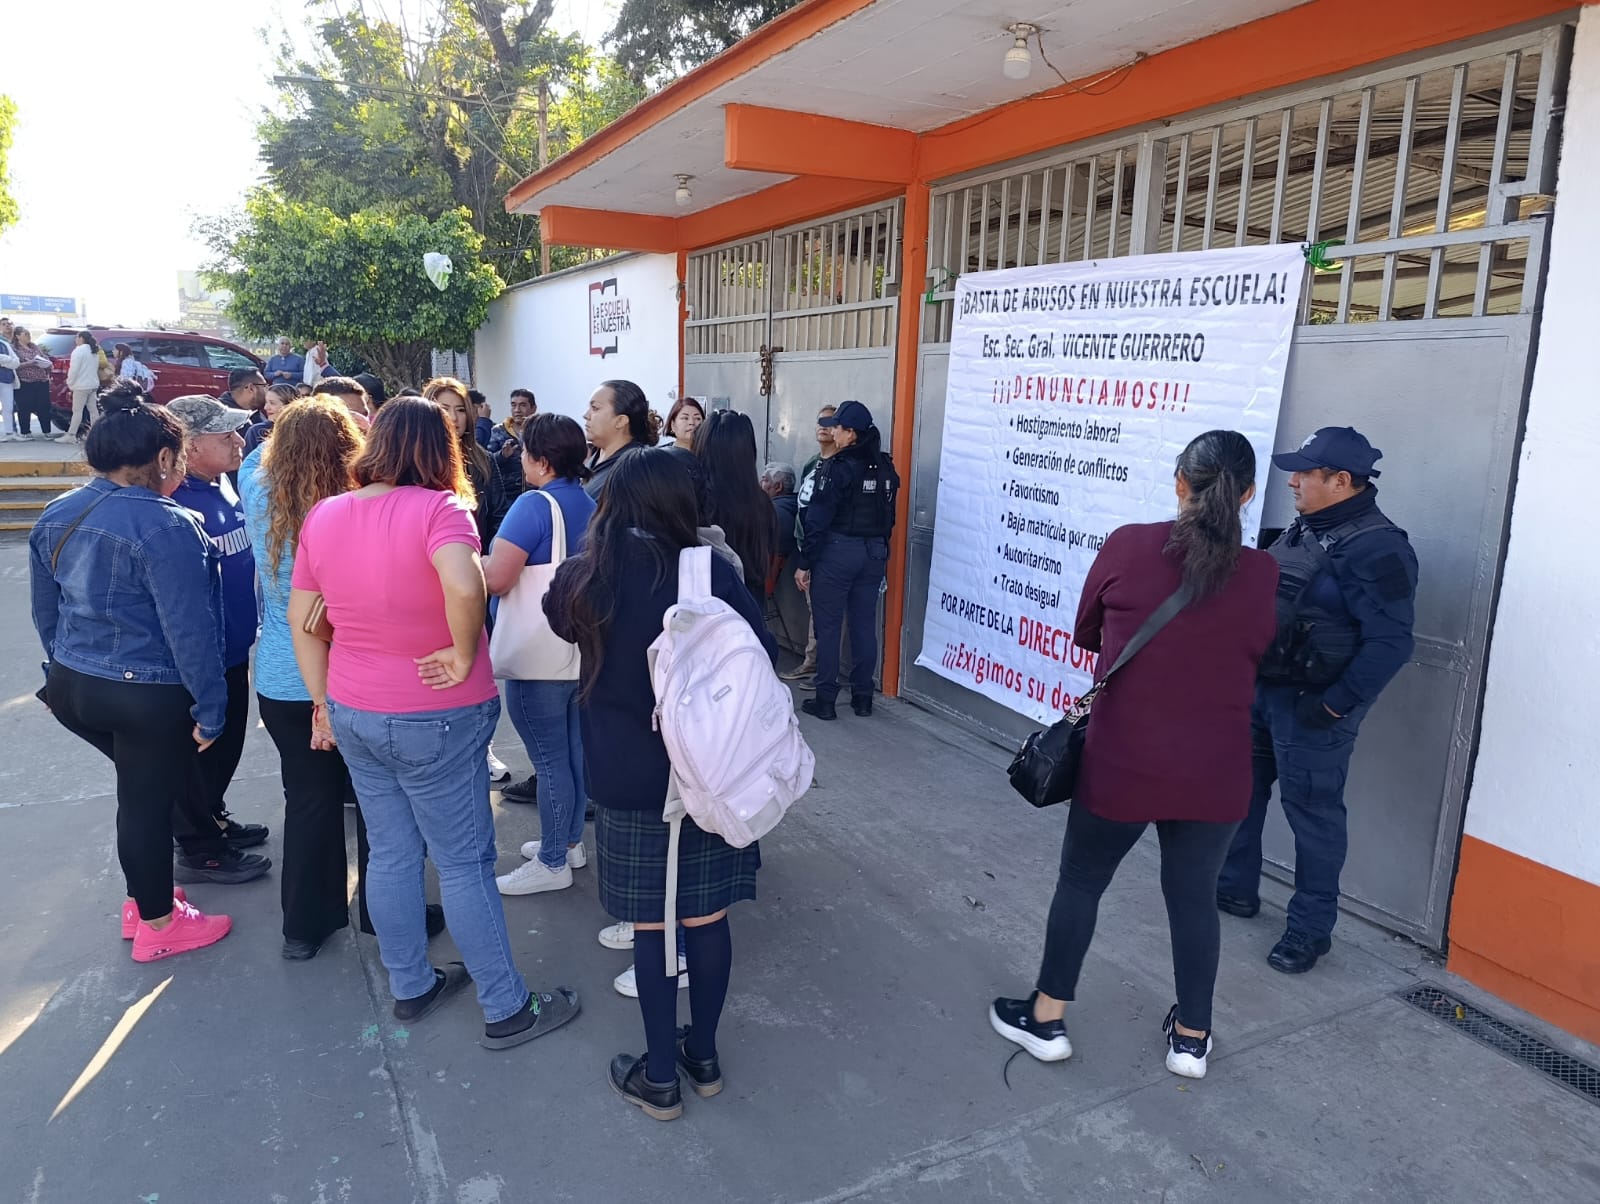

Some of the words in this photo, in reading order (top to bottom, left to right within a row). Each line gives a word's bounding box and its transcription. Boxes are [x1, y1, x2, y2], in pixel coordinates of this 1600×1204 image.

[600, 298, 631, 318] ESCUELA
[959, 290, 999, 320] ¡BASTA
[1002, 288, 1019, 313] DE
[1022, 285, 1076, 312] ABUSOS
[1080, 283, 1101, 310] EN
[1105, 278, 1182, 309] NUESTRA
[1189, 272, 1288, 307] ESCUELA!
[600, 315, 632, 334] NUESTRA
[982, 334, 1001, 358] Esc.
[1004, 333, 1025, 359] Sec.
[1028, 332, 1055, 359] Gral.
[1063, 333, 1118, 360] VICENTE
[1120, 332, 1205, 363] GUERRERO
[1016, 413, 1082, 440] Hostigamiento
[1083, 419, 1122, 444] laboral
[1012, 447, 1062, 472] Generación
[1063, 453, 1076, 475] de
[1077, 457, 1129, 482] conflictos
[1009, 479, 1060, 506] Favoritismo
[210, 526, 251, 557] PUM
[1007, 512, 1026, 536] Baja
[1027, 519, 1067, 543] matrícula
[1068, 530, 1087, 550] por
[1003, 542, 1062, 575] Autoritarismo
[1001, 573, 1023, 597] Trato
[1025, 580, 1061, 610] desigual
[941, 592, 958, 616] POR
[959, 599, 986, 626] PARTE
[988, 608, 1000, 631] DE
[1001, 614, 1014, 637] LA
[1027, 677, 1046, 703] su
